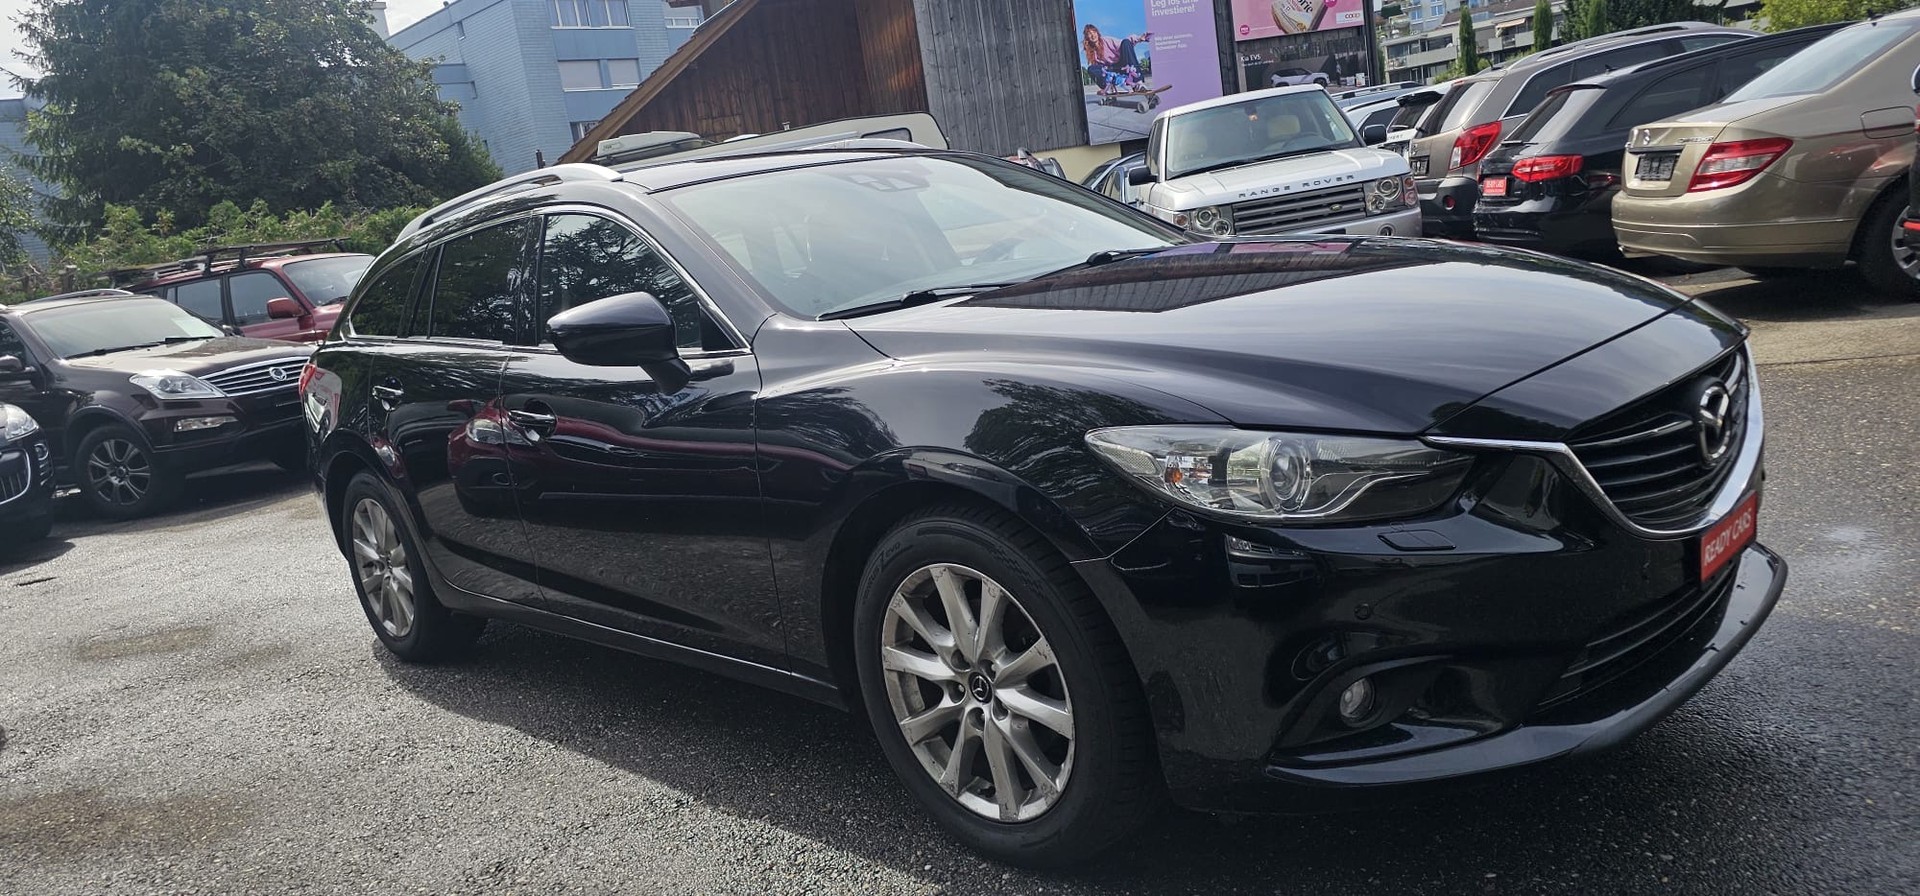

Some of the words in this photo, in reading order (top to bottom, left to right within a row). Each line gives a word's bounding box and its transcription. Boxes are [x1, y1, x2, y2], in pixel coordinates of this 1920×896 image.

[1151, 4, 1195, 16] investiere!
[1238, 185, 1291, 198] RANGE
[1302, 174, 1354, 187] ROVER
[1704, 525, 1732, 566] READY
[1732, 507, 1752, 540] CARS
